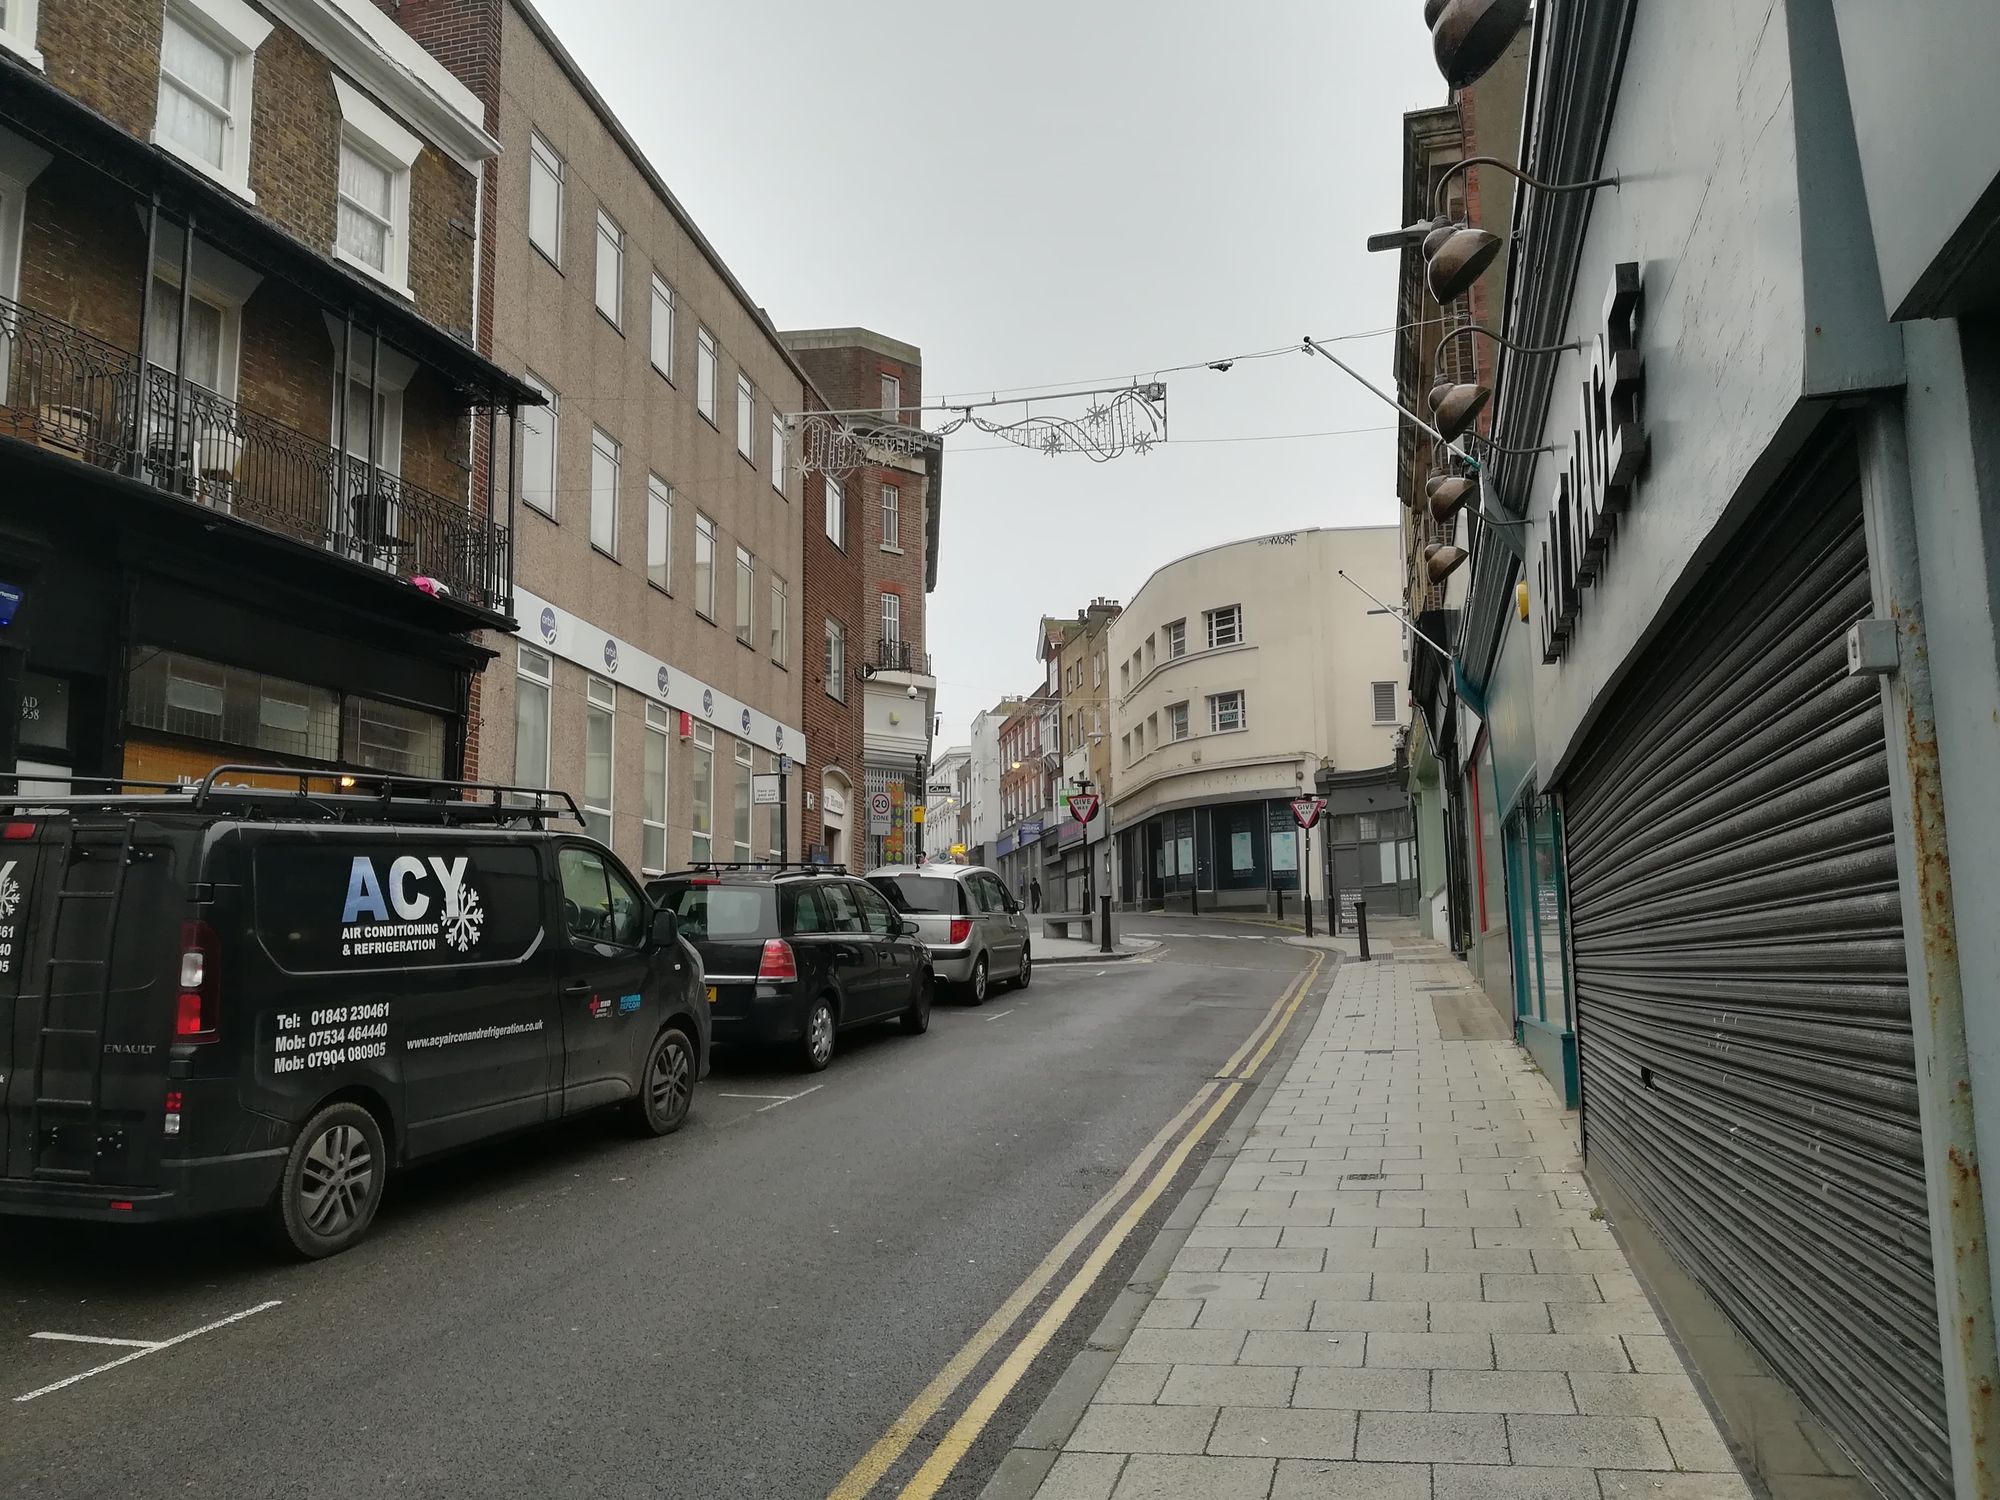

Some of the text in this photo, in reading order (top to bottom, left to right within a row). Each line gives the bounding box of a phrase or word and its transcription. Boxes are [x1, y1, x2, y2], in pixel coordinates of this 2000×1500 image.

[542, 615, 554, 627] orbit
[606, 647, 616, 658] orbit
[875, 800, 887, 808] 20
[342, 856, 468, 922] ACY
[342, 923, 439, 939] AIR CONDITIONING
[342, 939, 436, 956] & REFRIGERATION
[277, 1002, 390, 1030] Tel: 01843 230461
[275, 1023, 388, 1052] Mob: 07534 464440
[407, 1019, 544, 1050] www.acyairconandrefrigeration.co.uk
[103, 1044, 157, 1054] ENAULT
[274, 1042, 386, 1073] Mob: 07904 080905
